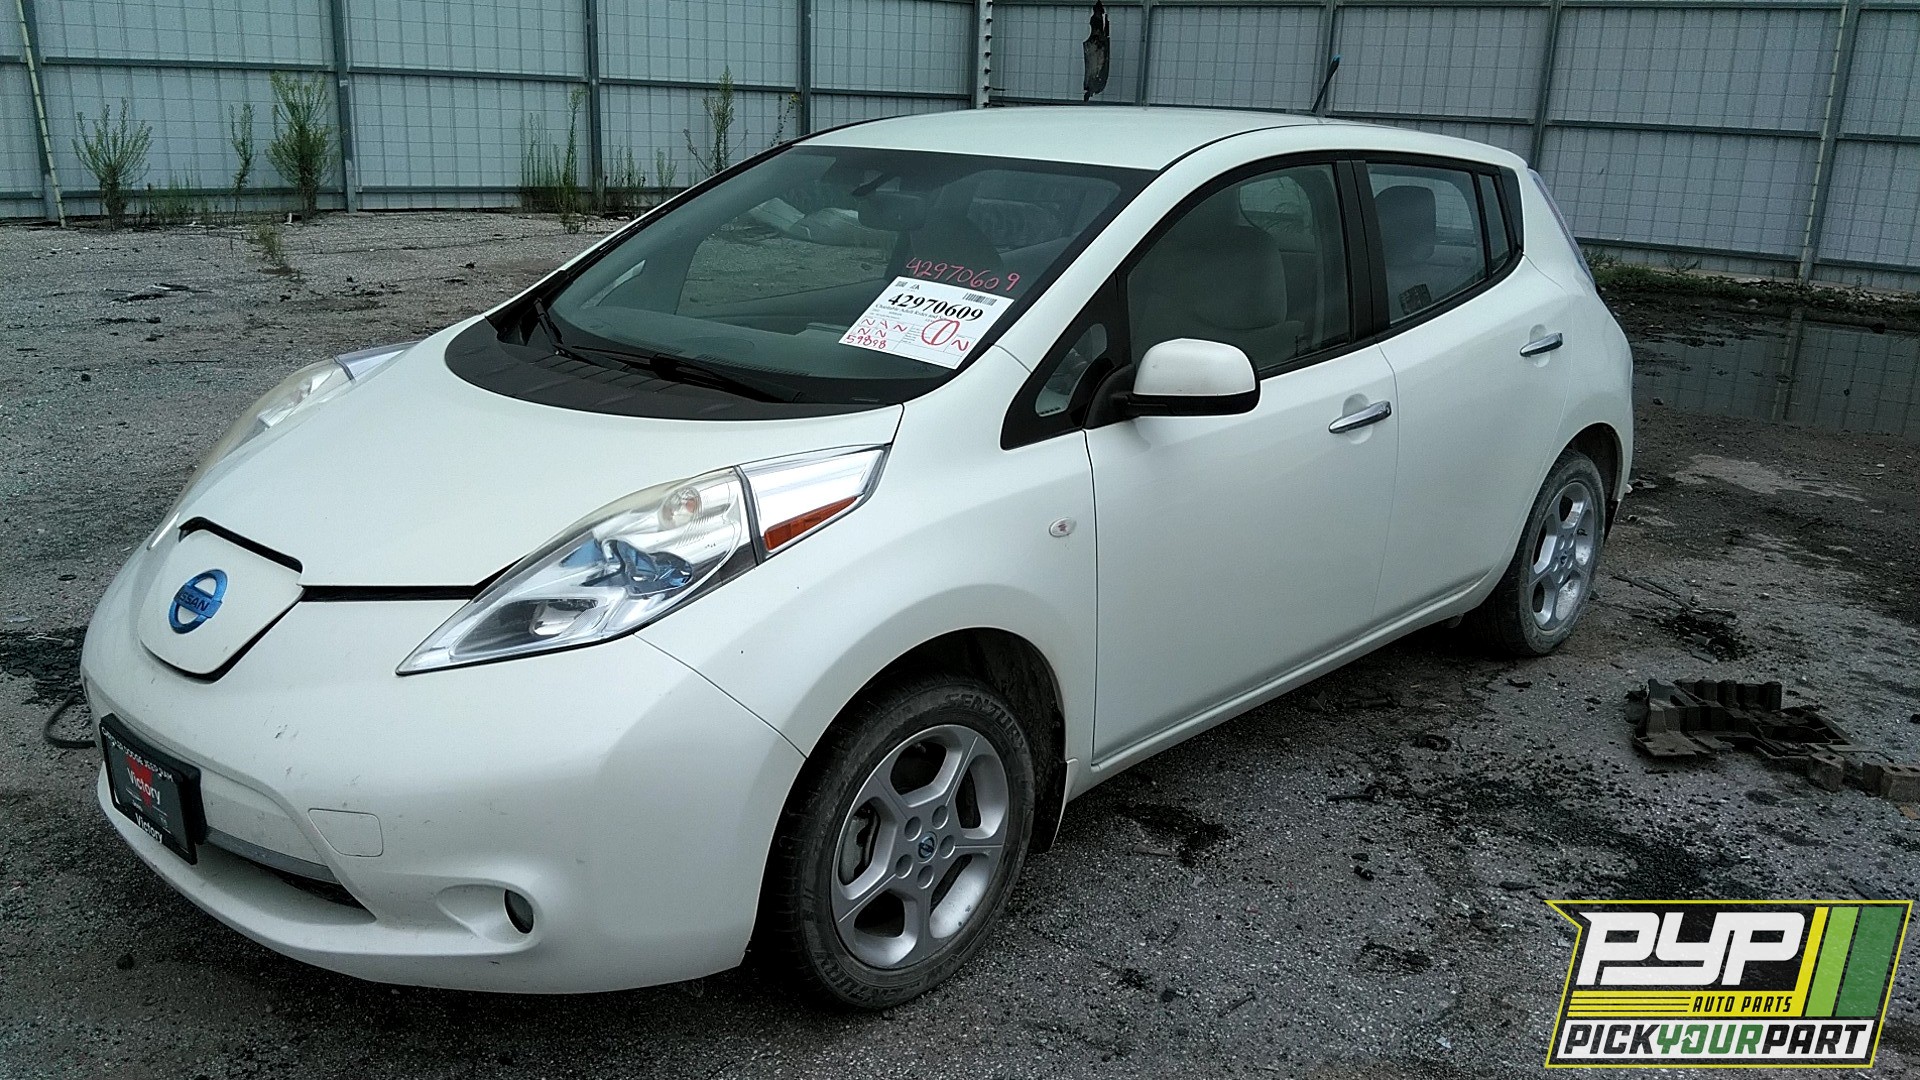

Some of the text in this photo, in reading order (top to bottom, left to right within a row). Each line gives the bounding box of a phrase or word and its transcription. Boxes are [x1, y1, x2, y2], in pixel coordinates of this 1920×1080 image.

[906, 257, 1020, 291] 42970609
[887, 293, 984, 321] 42970609
[127, 767, 161, 805] Victory
[134, 812, 163, 844] Victory
